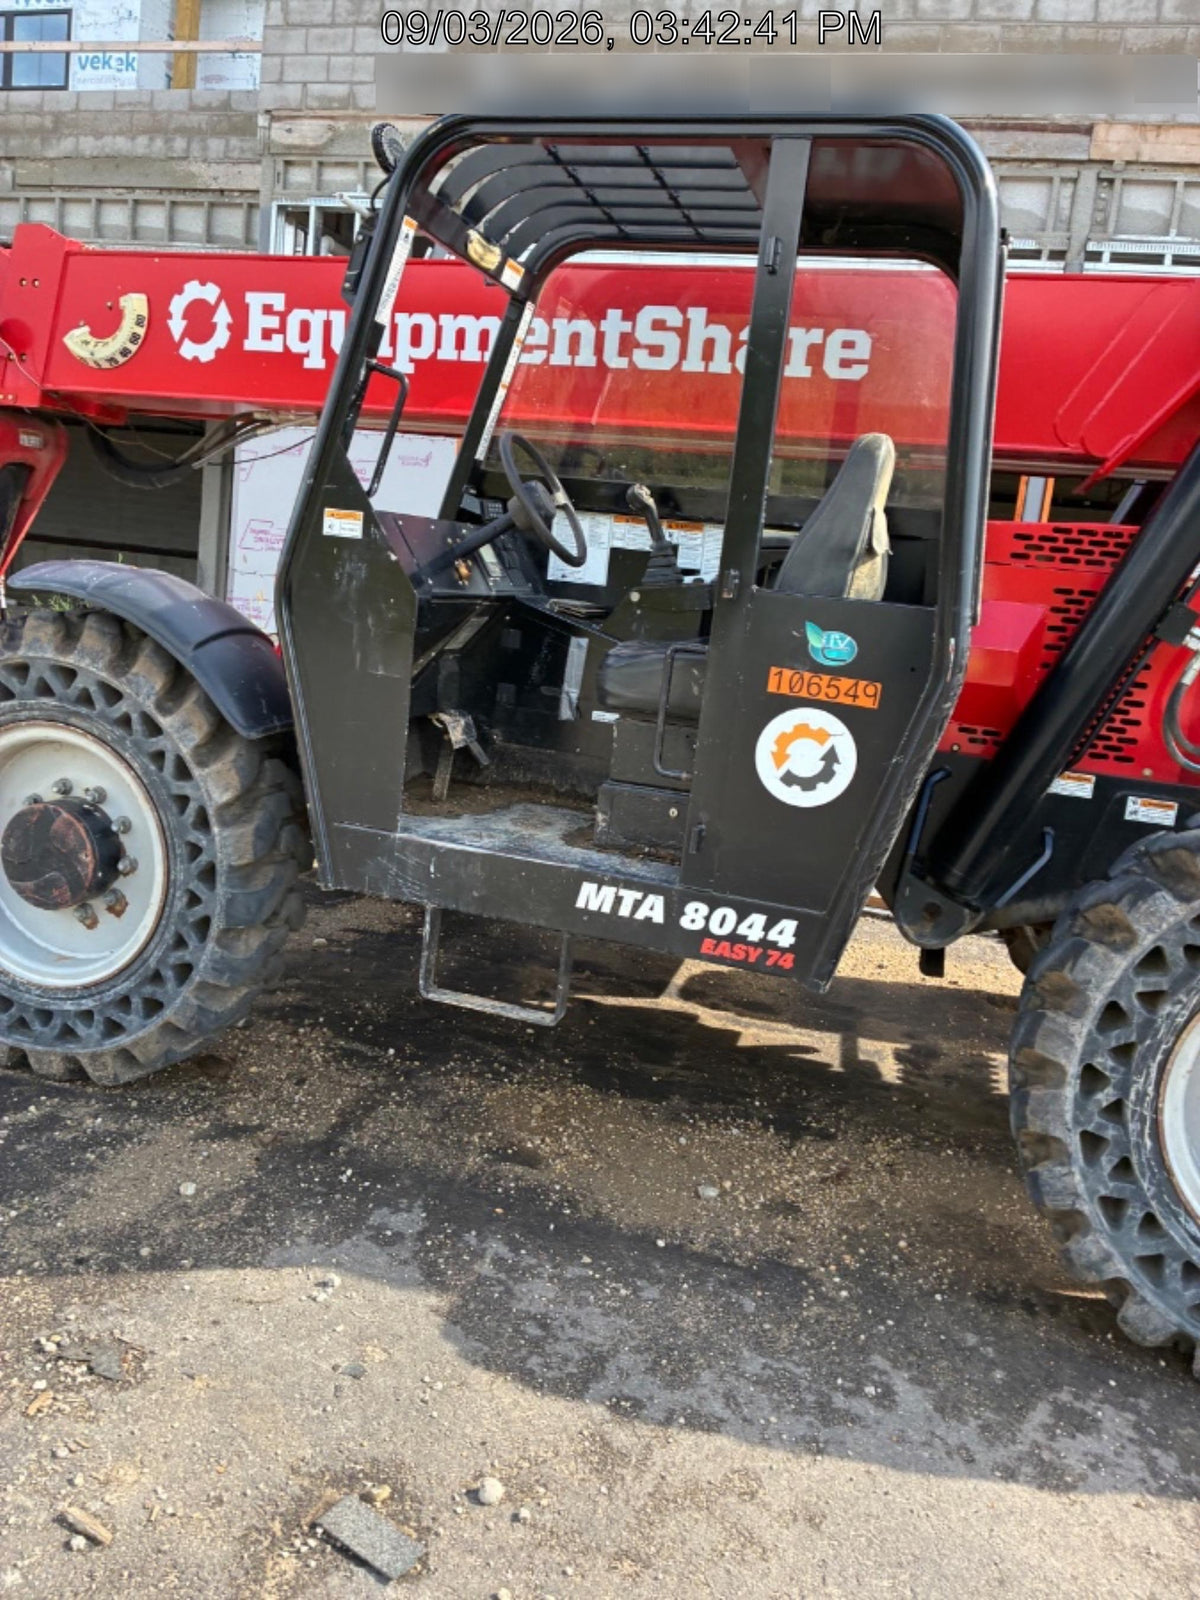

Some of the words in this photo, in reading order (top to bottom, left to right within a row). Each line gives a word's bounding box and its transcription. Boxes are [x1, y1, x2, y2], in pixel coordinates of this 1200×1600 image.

[243, 291, 873, 381] EqpmentShre
[773, 669, 879, 707] 106549
[575, 881, 665, 925] MTA
[679, 901, 799, 949] 8044
[700, 938, 763, 963] EASY
[765, 950, 796, 970] 74
